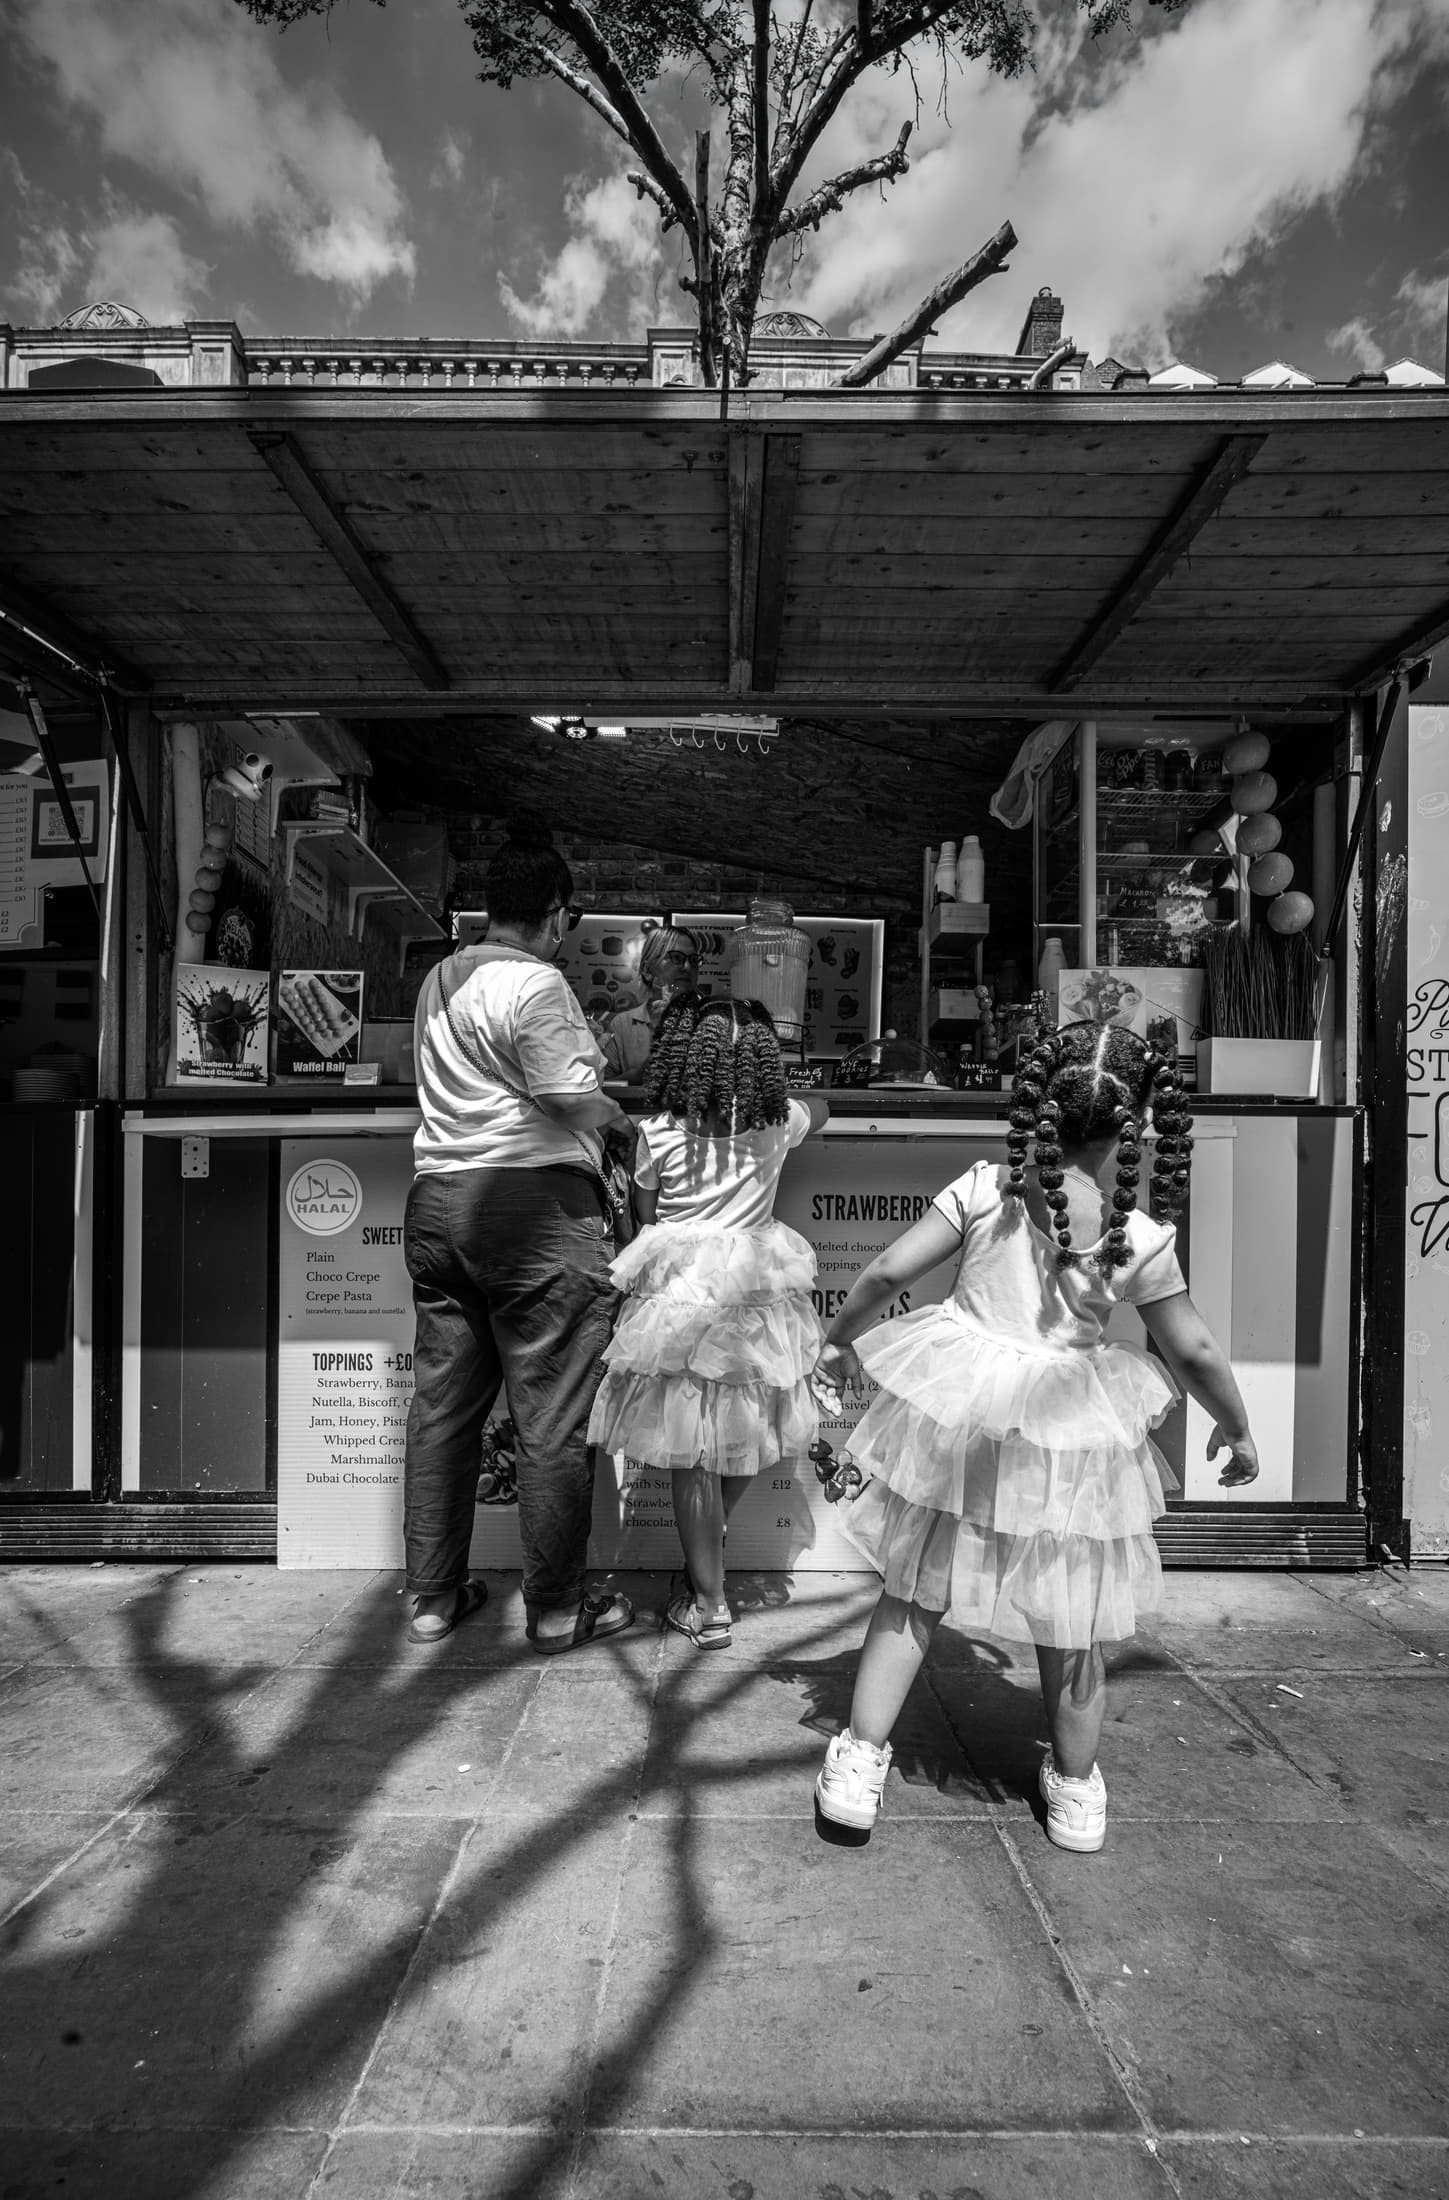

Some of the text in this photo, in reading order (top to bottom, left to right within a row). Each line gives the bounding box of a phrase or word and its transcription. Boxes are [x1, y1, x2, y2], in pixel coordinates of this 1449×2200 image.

[191, 1060, 233, 1070] Strawberry
[293, 1062, 322, 1072] Waffel
[216, 1068, 255, 1077] Chocolate
[297, 1204, 350, 1214] HALAL
[851, 1241, 889, 1252] chocol
[306, 1251, 335, 1262] Plain
[817, 1259, 862, 1271] oppings
[306, 1271, 381, 1285] Choco Crepe
[306, 1291, 372, 1304] Crepe Pasta
[312, 1353, 373, 1371] TOPPINGS
[317, 1378, 383, 1391] Strawberry,
[312, 1396, 356, 1408] Nutella,
[359, 1396, 401, 1408] Biscoff,
[309, 1416, 336, 1429] Jam,
[339, 1416, 379, 1429] Honey,
[324, 1435, 406, 1448] Whipped Crea
[306, 1472, 399, 1484] Dubai Chocolate
[626, 1478, 651, 1489] with
[771, 1480, 792, 1490] £12
[626, 1498, 673, 1508] Strawbe
[776, 1518, 792, 1528] £8
